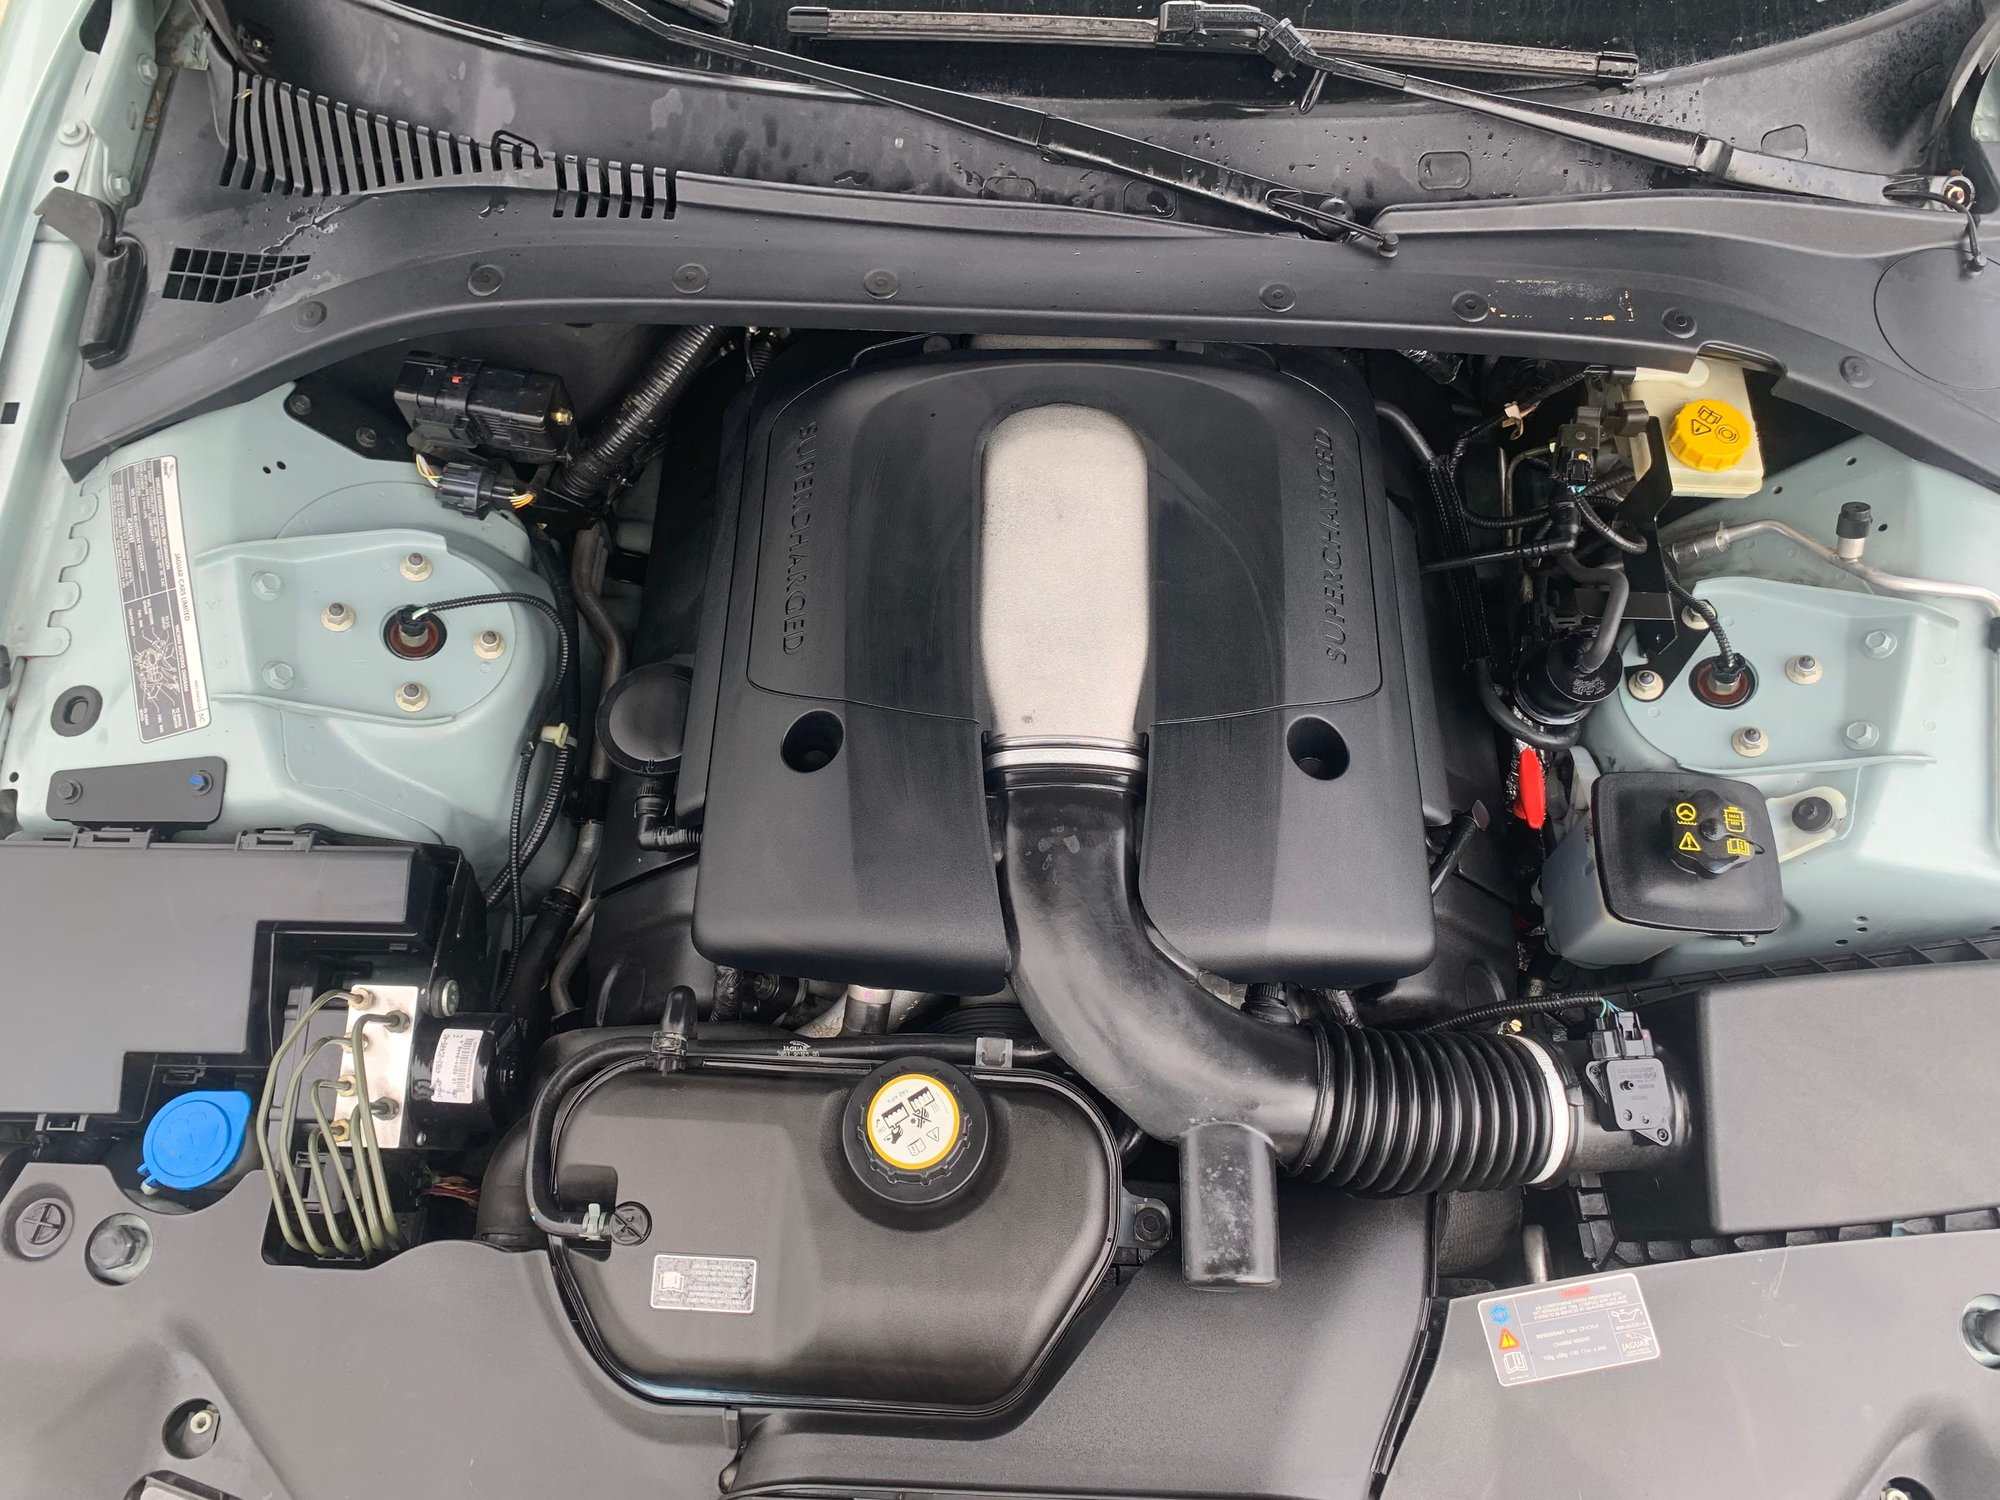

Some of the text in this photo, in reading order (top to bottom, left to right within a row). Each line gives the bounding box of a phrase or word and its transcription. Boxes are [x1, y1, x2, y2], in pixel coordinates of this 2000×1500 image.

[783, 421, 818, 656] SUPERCHARGED
[1313, 427, 1347, 664] SUPERCHARGED
[174, 553, 190, 621] JAGUAR CARS LIMITED
[198, 713, 205, 723] 5C
[1621, 1339, 1650, 1351] JAGUAR
